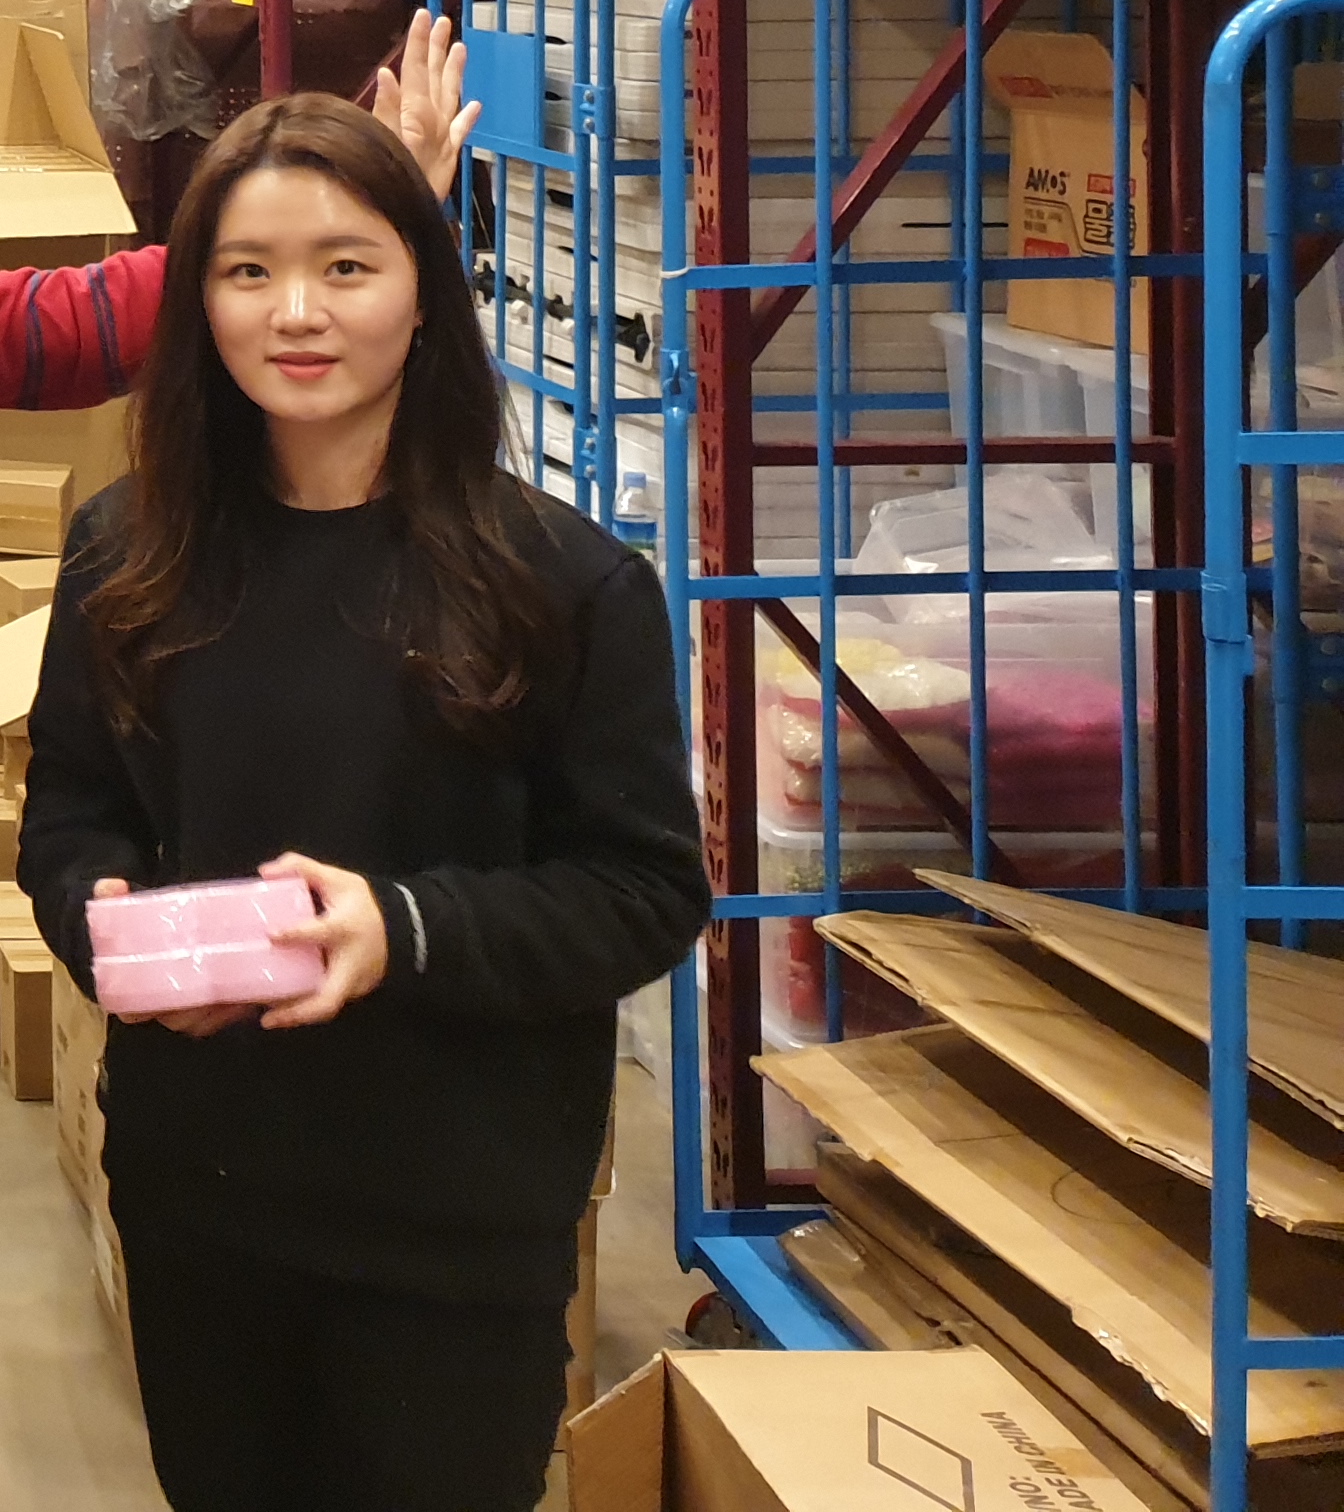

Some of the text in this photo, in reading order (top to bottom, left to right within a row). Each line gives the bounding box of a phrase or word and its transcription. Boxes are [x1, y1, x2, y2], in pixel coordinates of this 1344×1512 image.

[980, 1411, 1104, 1512] ADE IN CHINA
